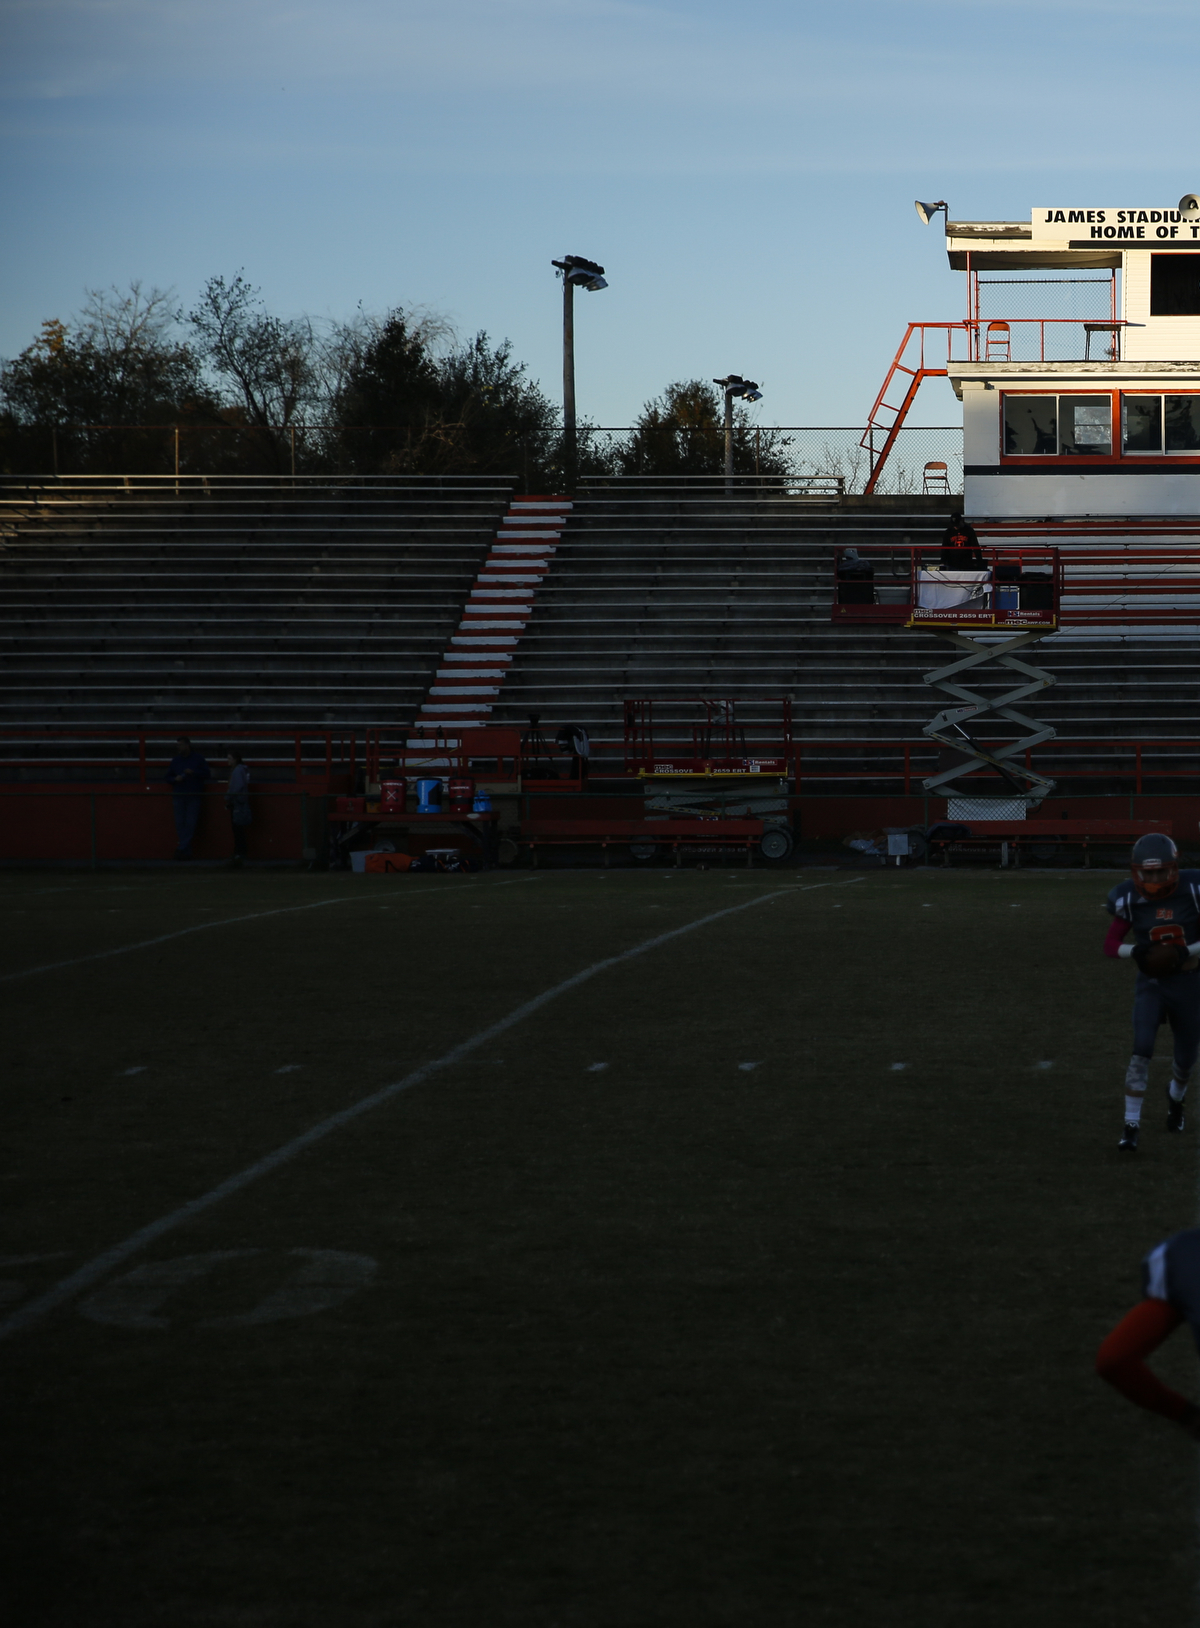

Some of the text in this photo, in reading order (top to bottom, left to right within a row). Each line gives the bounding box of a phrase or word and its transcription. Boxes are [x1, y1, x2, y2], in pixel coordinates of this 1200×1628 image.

[1045, 210, 1105, 223] JAMES
[1091, 226, 1145, 238] HOME
[1156, 225, 1179, 238] OF
[1156, 908, 1174, 920] ER
